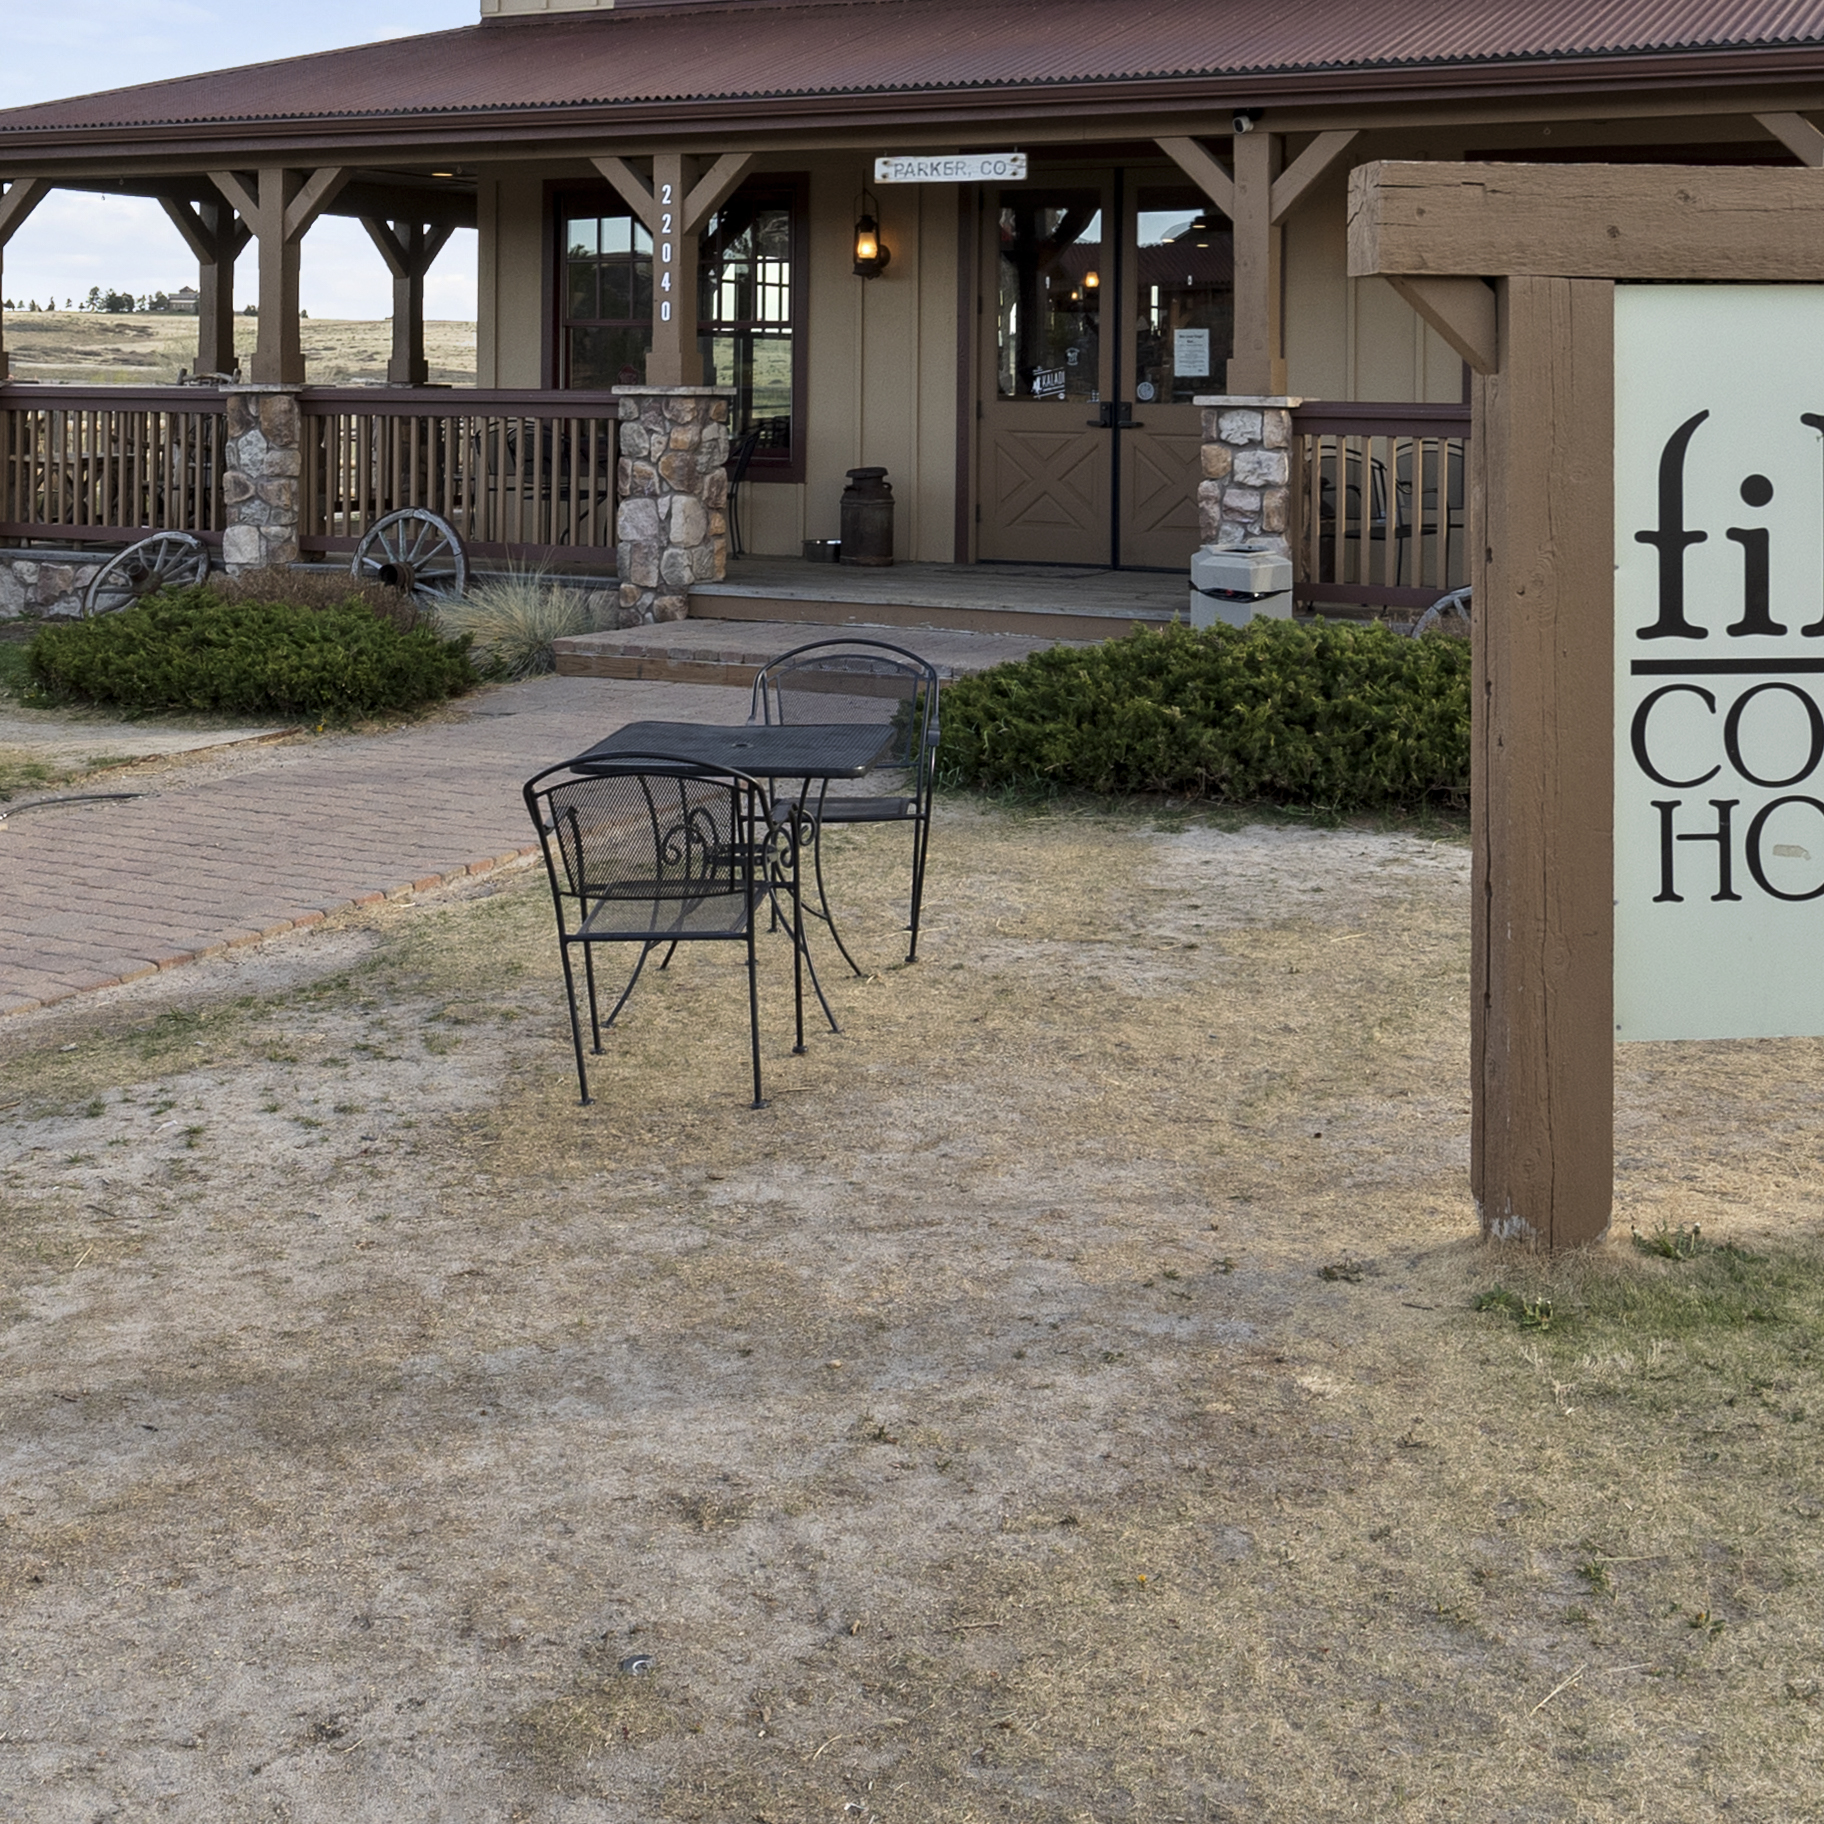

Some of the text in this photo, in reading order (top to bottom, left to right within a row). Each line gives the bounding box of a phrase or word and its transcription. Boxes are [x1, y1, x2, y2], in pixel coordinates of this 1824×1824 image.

[894, 160, 1007, 177] PARKER, CO
[661, 184, 671, 321] 22040
